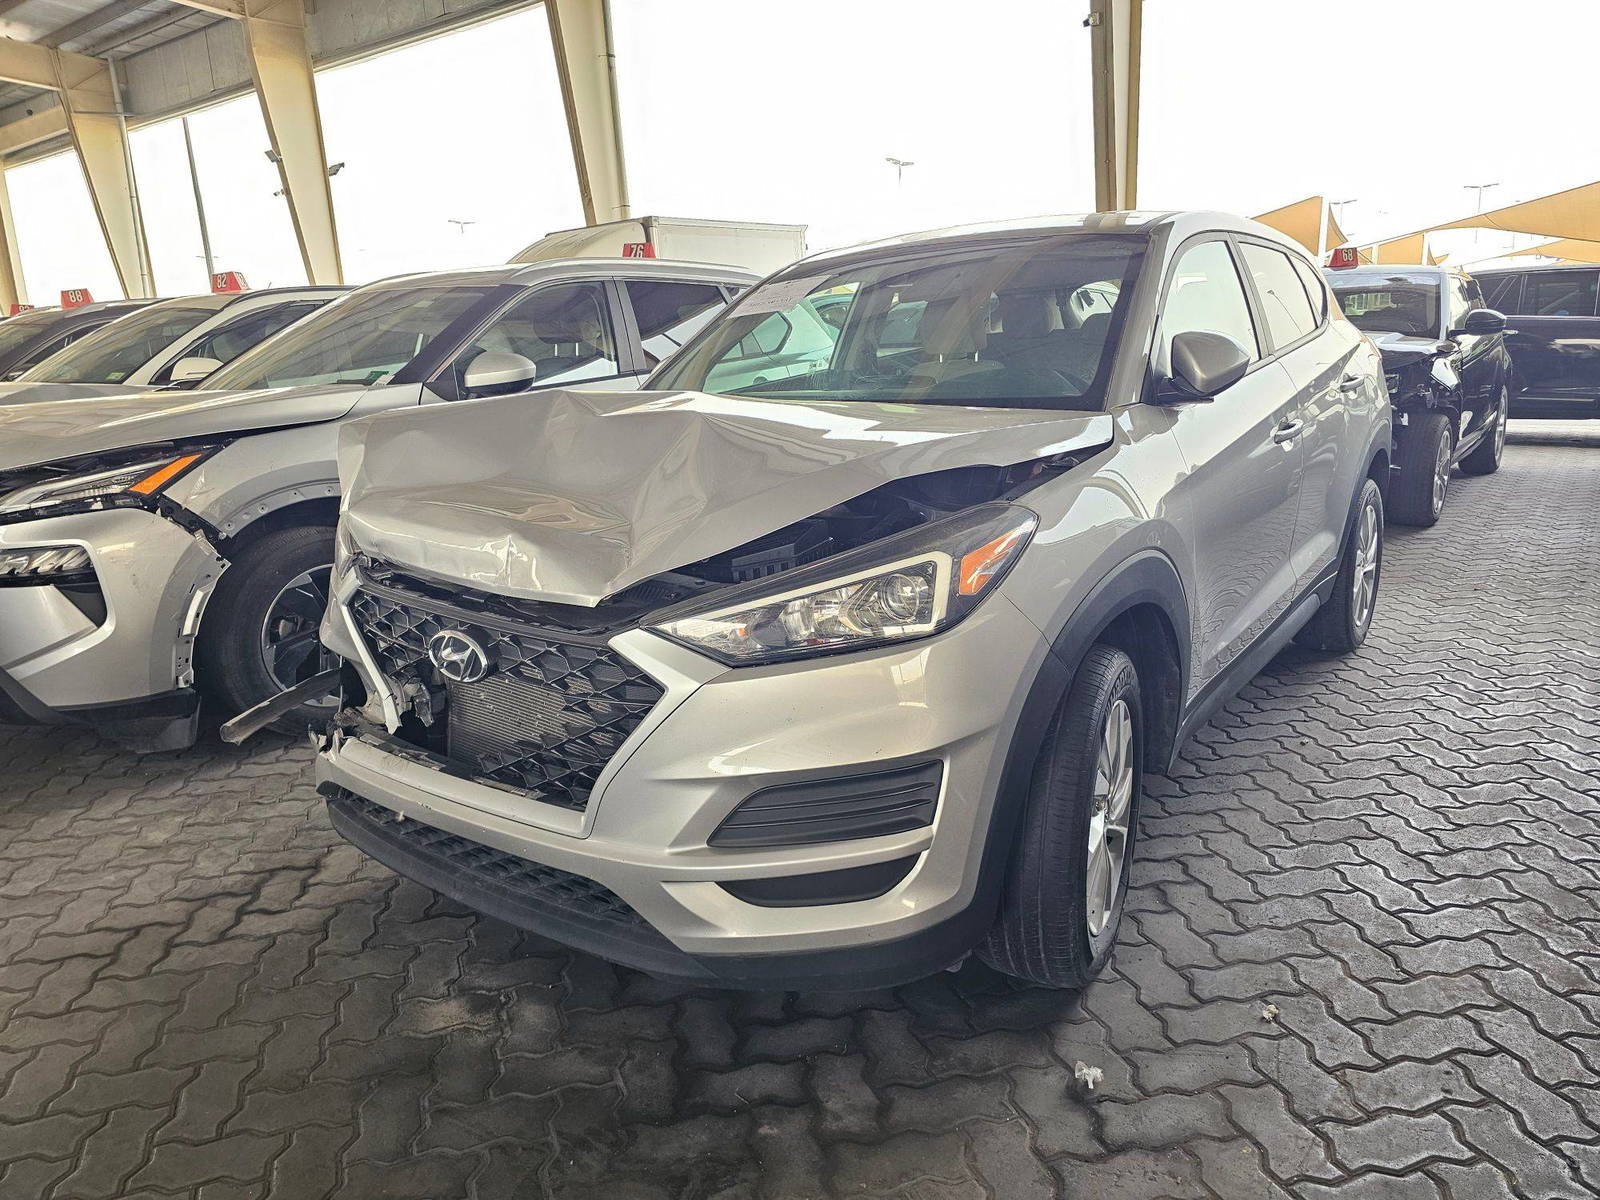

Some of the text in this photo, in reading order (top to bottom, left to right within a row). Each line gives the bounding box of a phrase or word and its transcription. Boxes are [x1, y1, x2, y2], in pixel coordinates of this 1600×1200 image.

[631, 244, 644, 258] 76
[1343, 249, 1353, 262] 68
[217, 274, 227, 288] 82
[69, 290, 83, 303] 88
